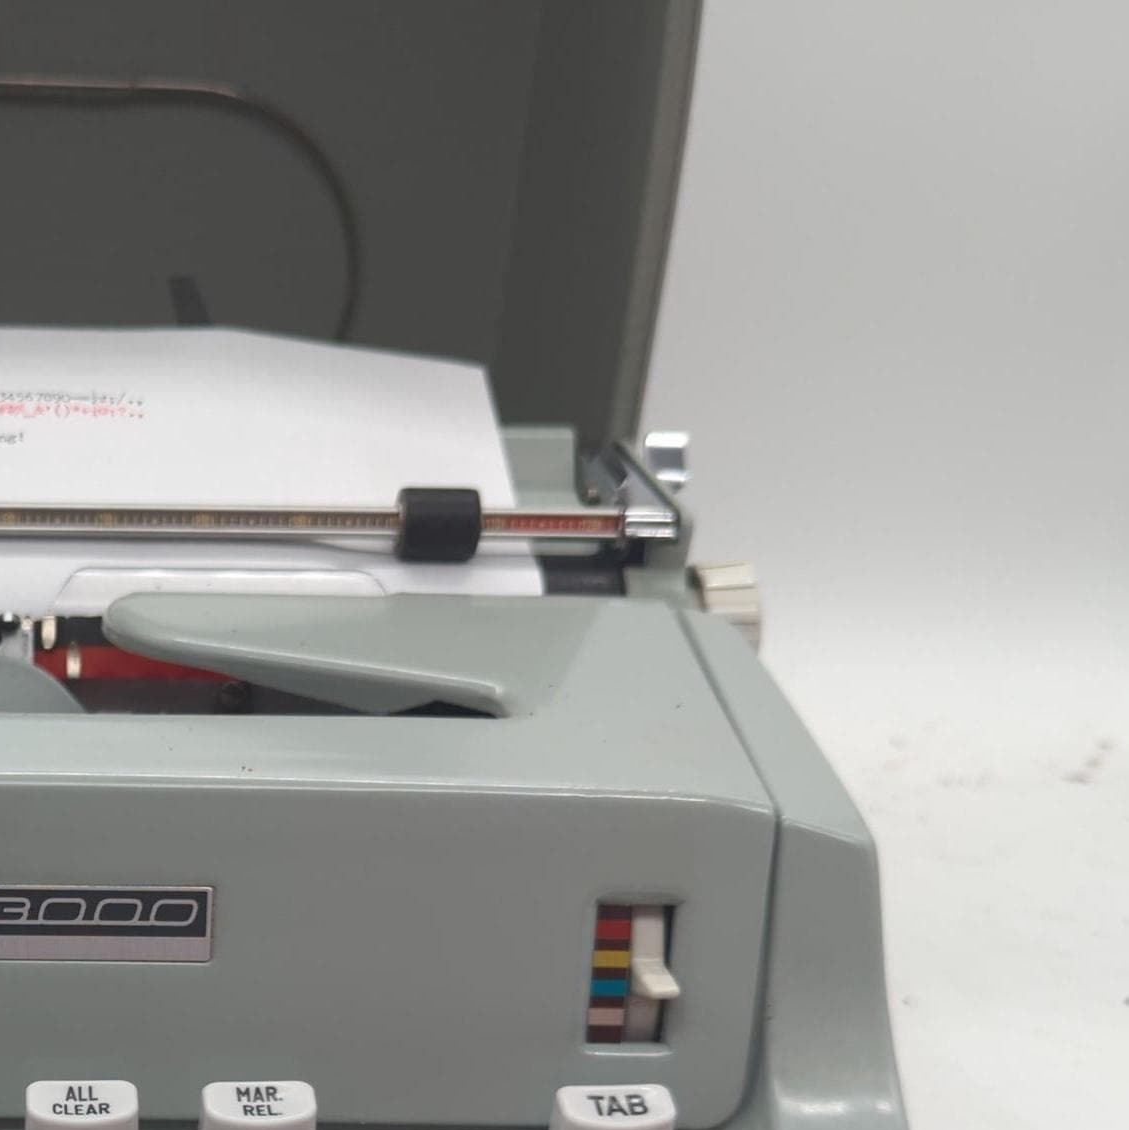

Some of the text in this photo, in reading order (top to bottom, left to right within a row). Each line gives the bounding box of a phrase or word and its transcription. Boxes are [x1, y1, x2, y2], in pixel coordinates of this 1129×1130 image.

[65, 1085, 99, 1102] ALL
[236, 1086, 283, 1103] MAR.
[52, 1102, 110, 1116] CLEAR
[243, 1104, 283, 1117] REL.
[587, 1094, 649, 1117] TAB
